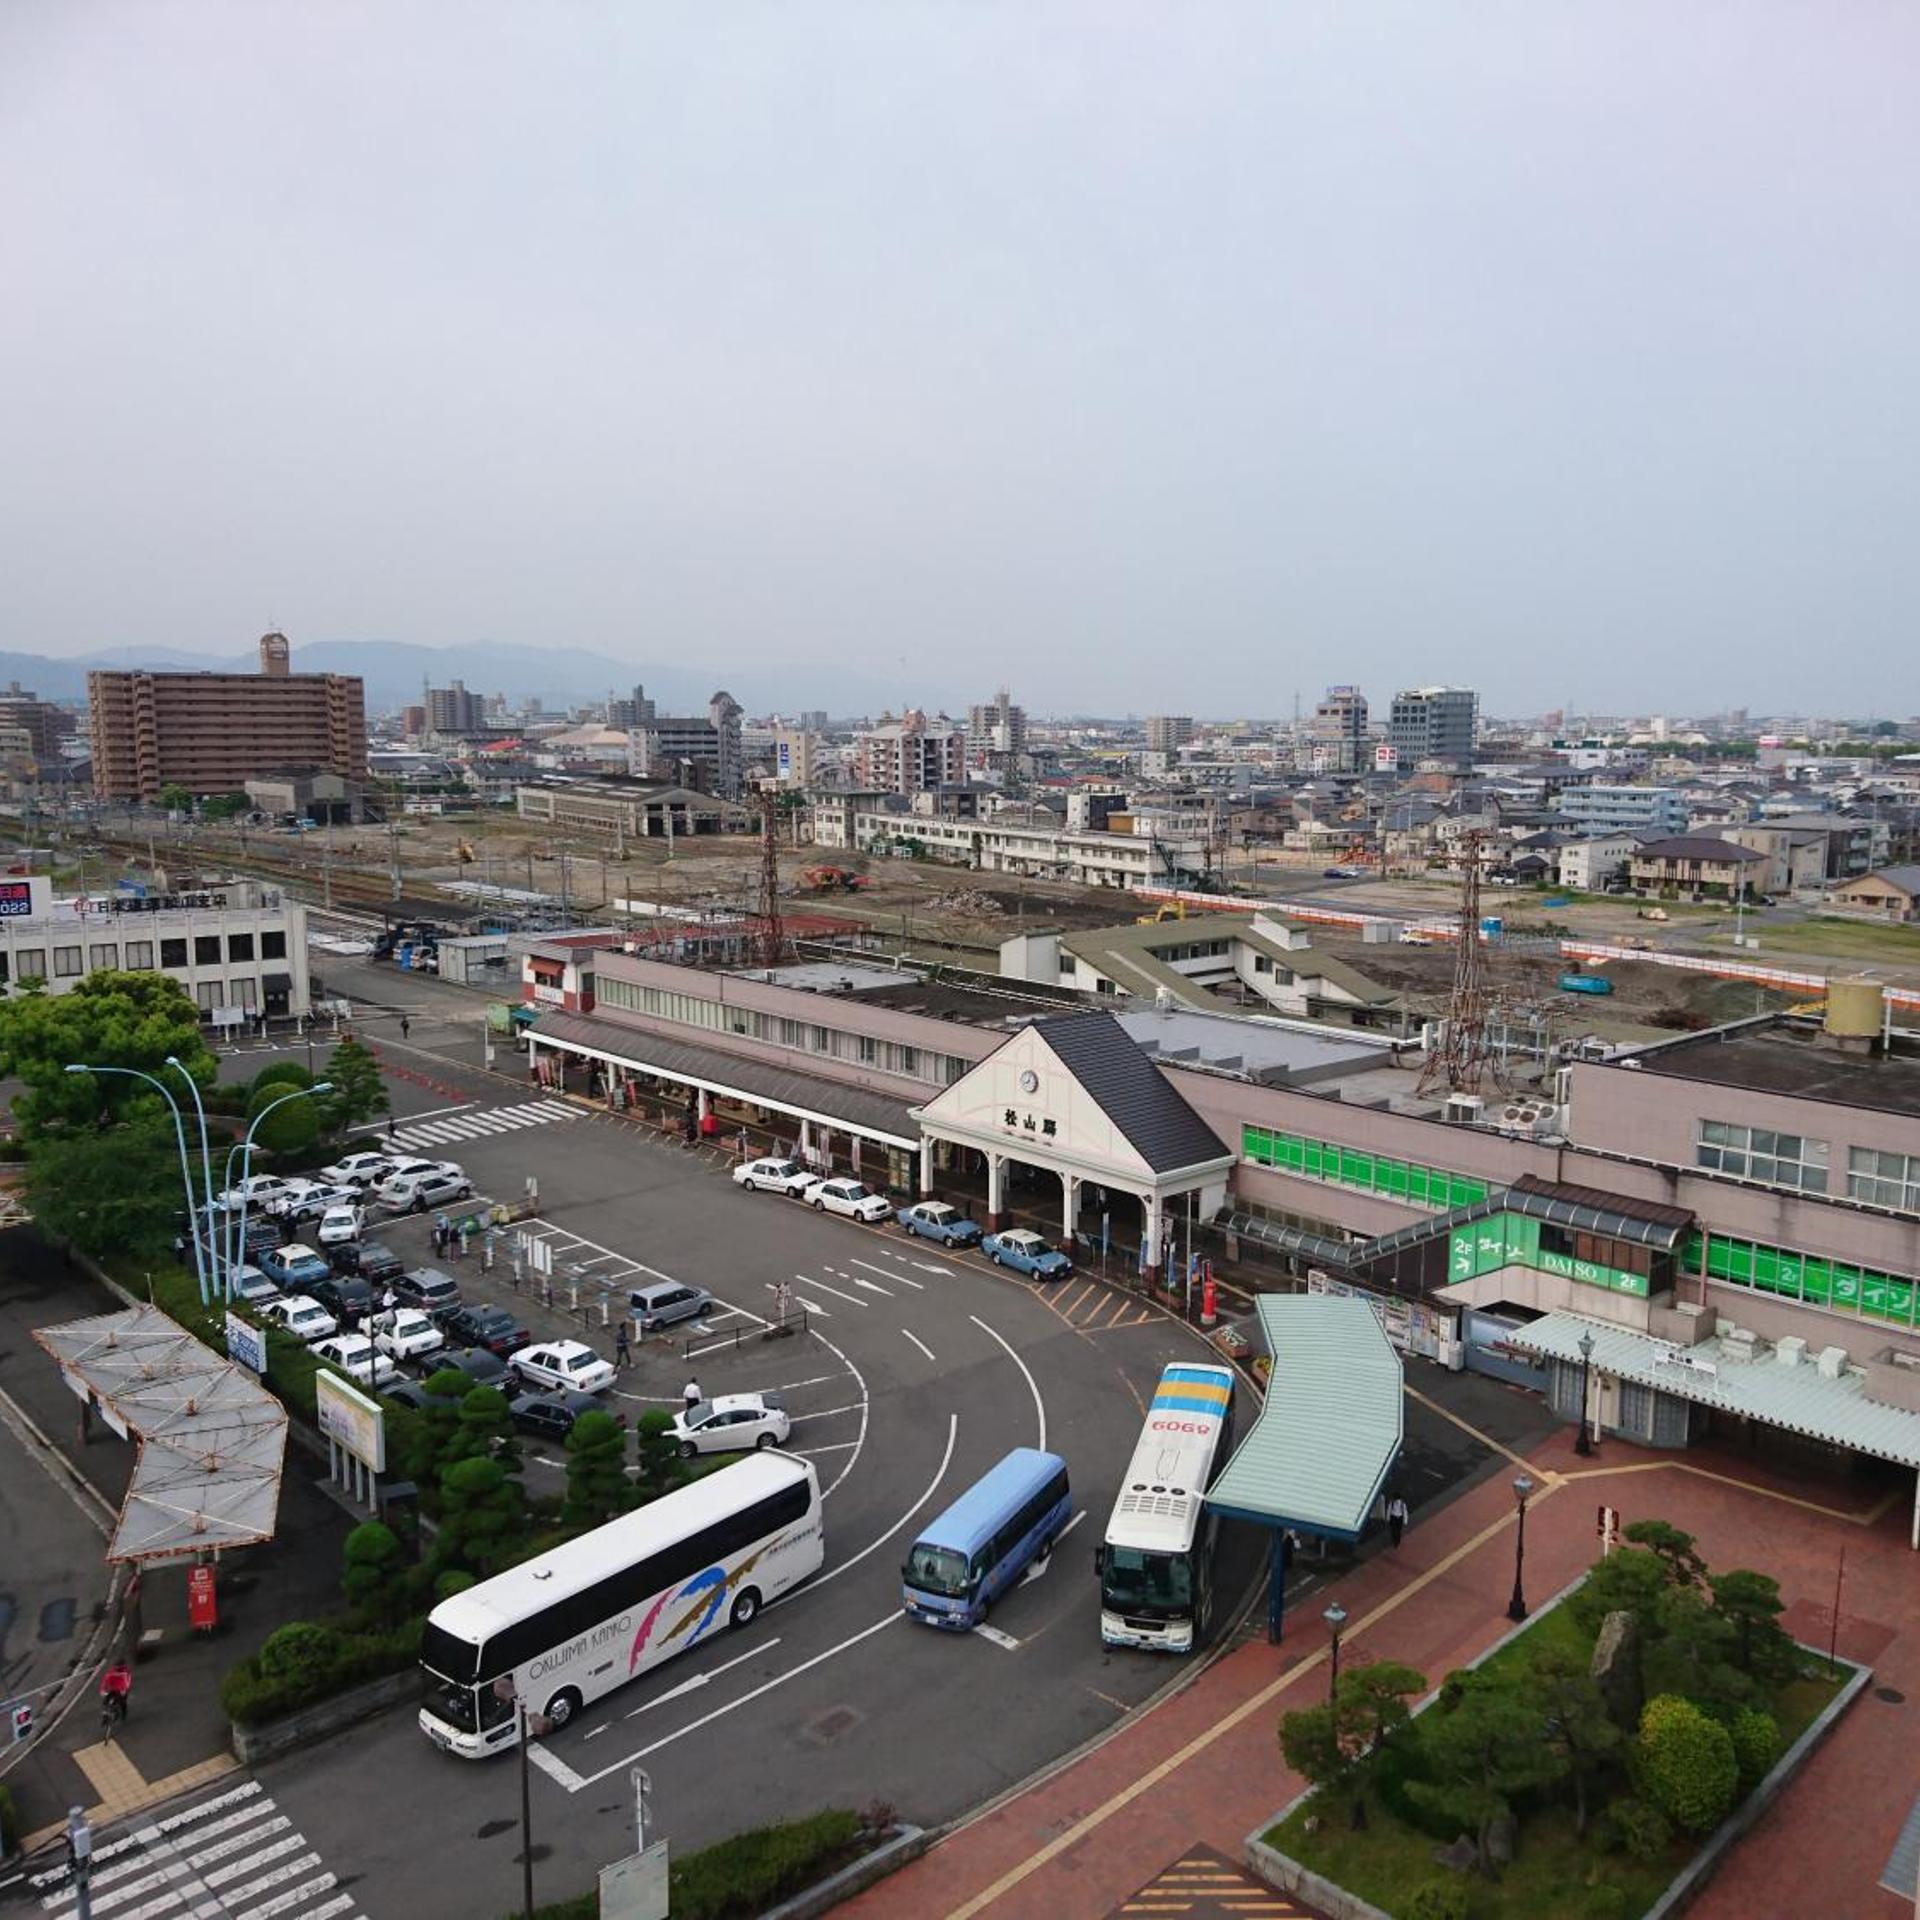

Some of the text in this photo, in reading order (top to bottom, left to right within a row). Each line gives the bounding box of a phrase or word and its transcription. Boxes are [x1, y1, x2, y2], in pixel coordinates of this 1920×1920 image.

[1455, 1238, 1473, 1255] 2F
[1544, 1254, 1637, 1290] DAISO 2F
[529, 1615, 632, 1680] OKUJIMA KANKO
